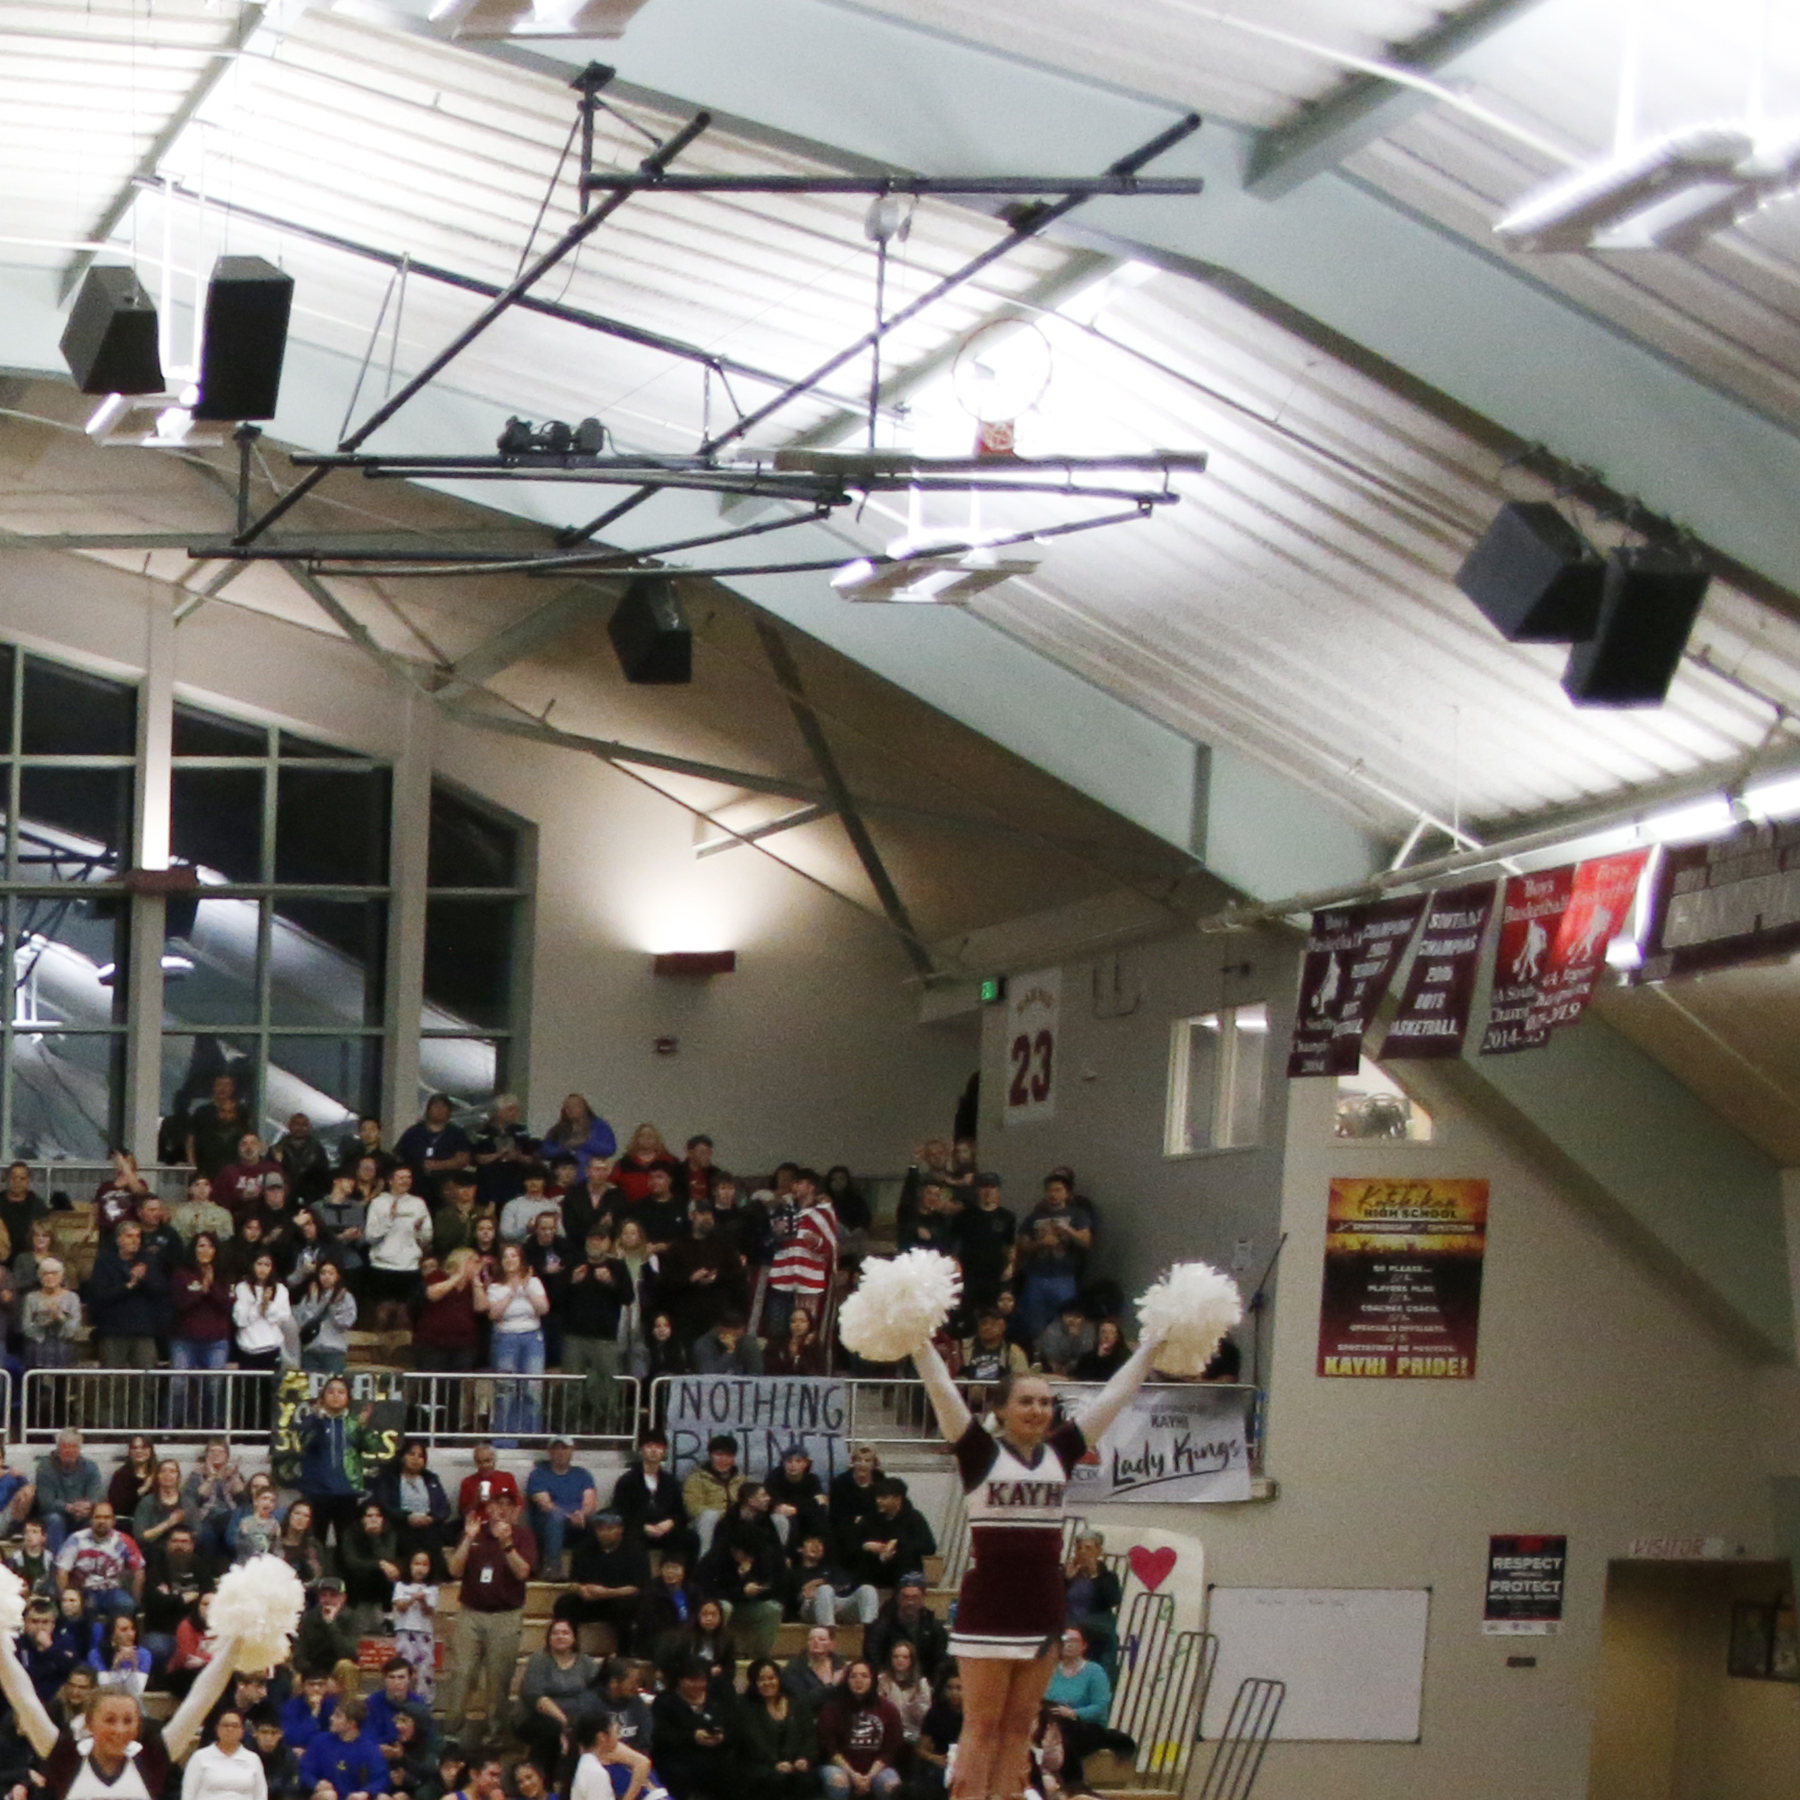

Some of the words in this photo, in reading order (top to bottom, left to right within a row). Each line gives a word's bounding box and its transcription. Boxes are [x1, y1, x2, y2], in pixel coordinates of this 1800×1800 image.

[1009, 1029, 1053, 1107] 23
[1364, 1208, 1398, 1219] HIGH
[1402, 1208, 1458, 1219] SCHOOL
[1324, 1356, 1388, 1376] KAYHI
[1396, 1356, 1469, 1377] PRIDE!
[679, 1380, 845, 1430] NOTHING
[1151, 1414, 1190, 1430] KAYHI
[1112, 1440, 1164, 1487] Lady
[1173, 1432, 1239, 1473] Kings
[987, 1481, 1064, 1508] KAYH
[1493, 1557, 1562, 1570] RESPECT
[1490, 1580, 1561, 1593] PROTECT
